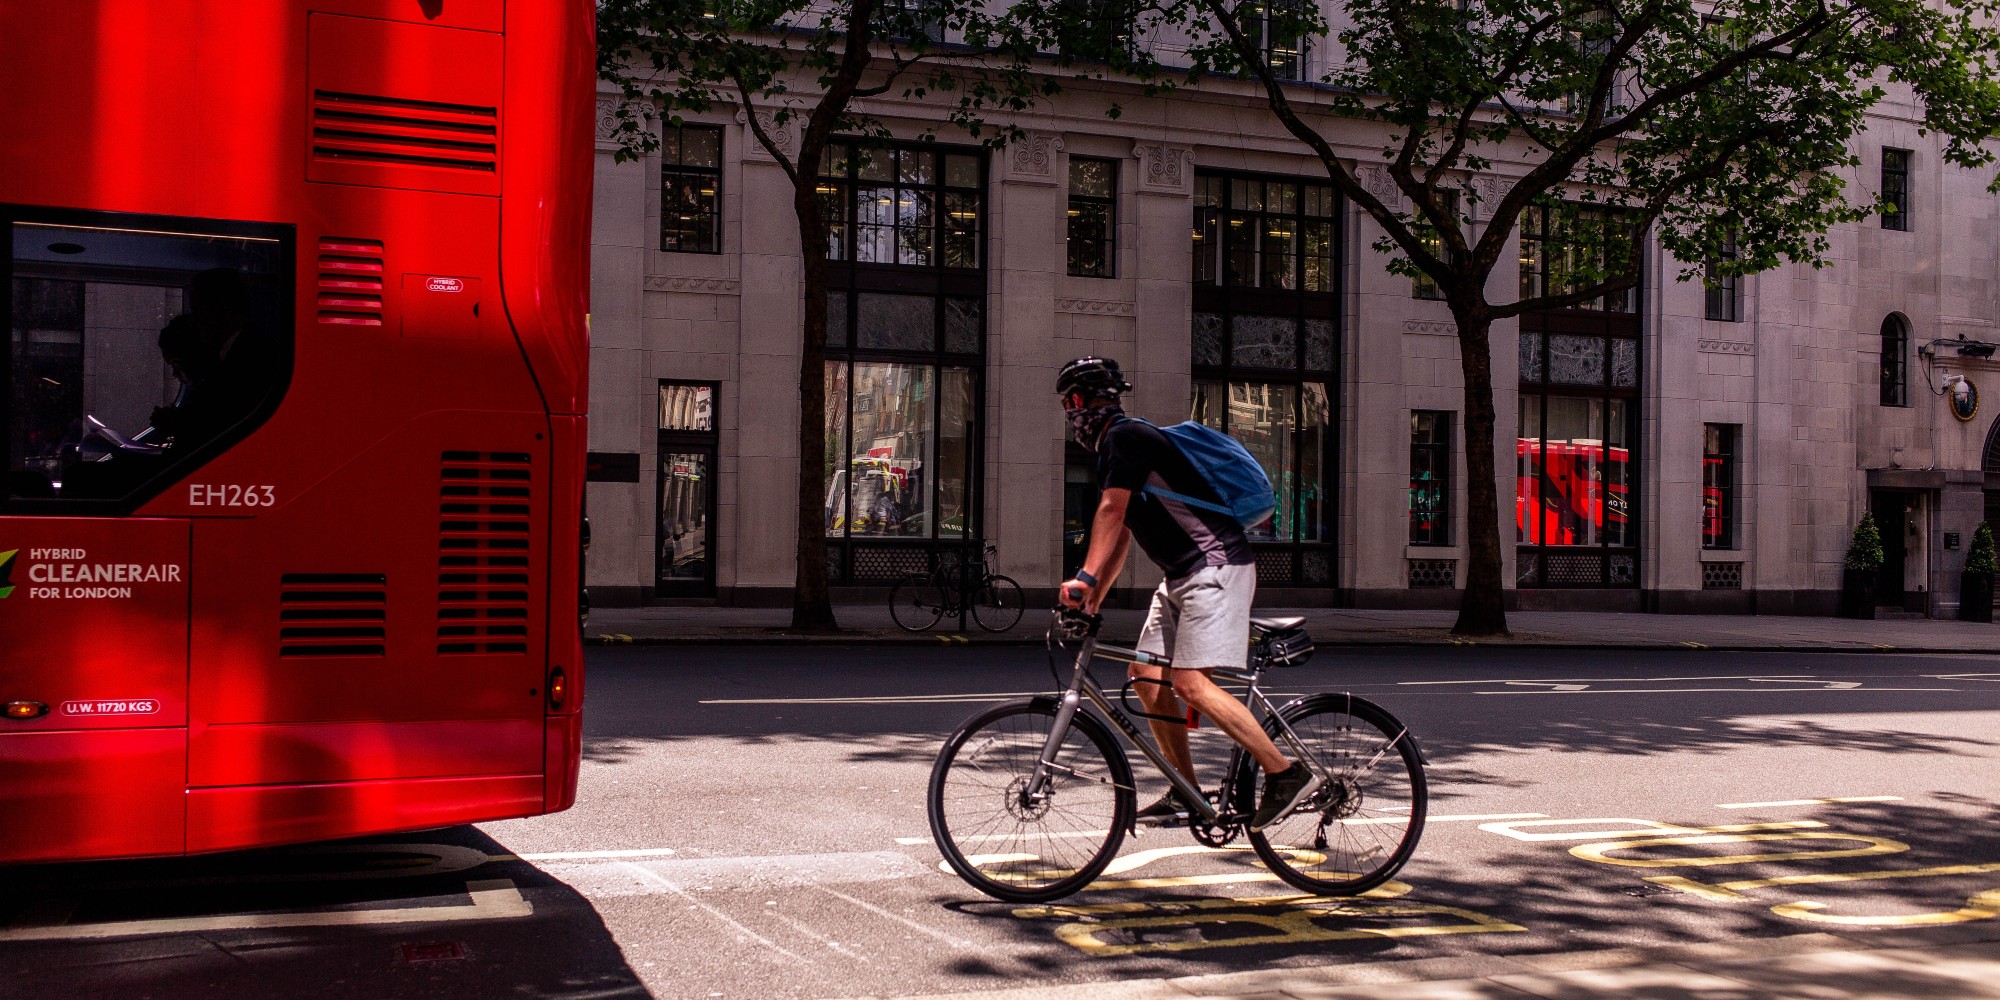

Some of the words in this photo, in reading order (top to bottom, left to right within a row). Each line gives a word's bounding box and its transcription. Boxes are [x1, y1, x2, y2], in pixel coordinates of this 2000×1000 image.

[189, 484, 276, 507] EH263
[30, 548, 87, 560] HYBRID
[28, 563, 182, 583] CLEANERAIR
[29, 587, 61, 599] FOR
[64, 587, 132, 599] LONDON
[66, 703, 95, 713] U.W.
[97, 702, 127, 712] 11720
[129, 701, 153, 711] KGS
